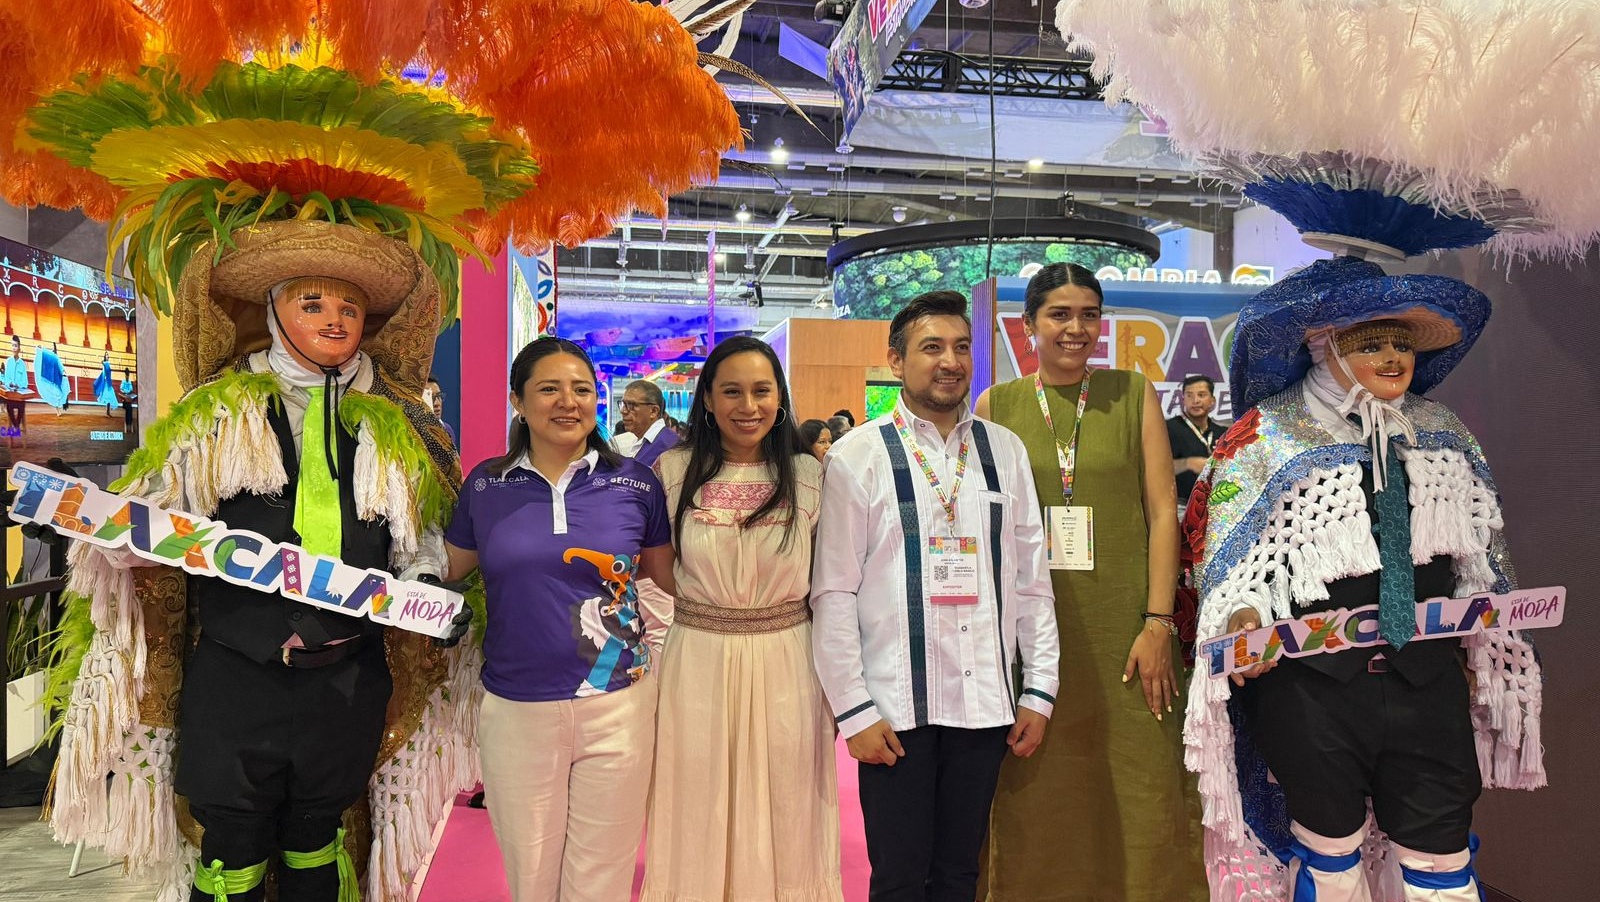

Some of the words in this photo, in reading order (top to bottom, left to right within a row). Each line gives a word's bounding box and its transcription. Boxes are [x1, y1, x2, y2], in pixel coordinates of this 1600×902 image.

[610, 476, 651, 492] SECTURE
[13, 466, 394, 618] TLAXCALA
[399, 598, 455, 628] MODA
[1508, 595, 1560, 626] MODA
[1202, 597, 1500, 676] TLAXCLA
